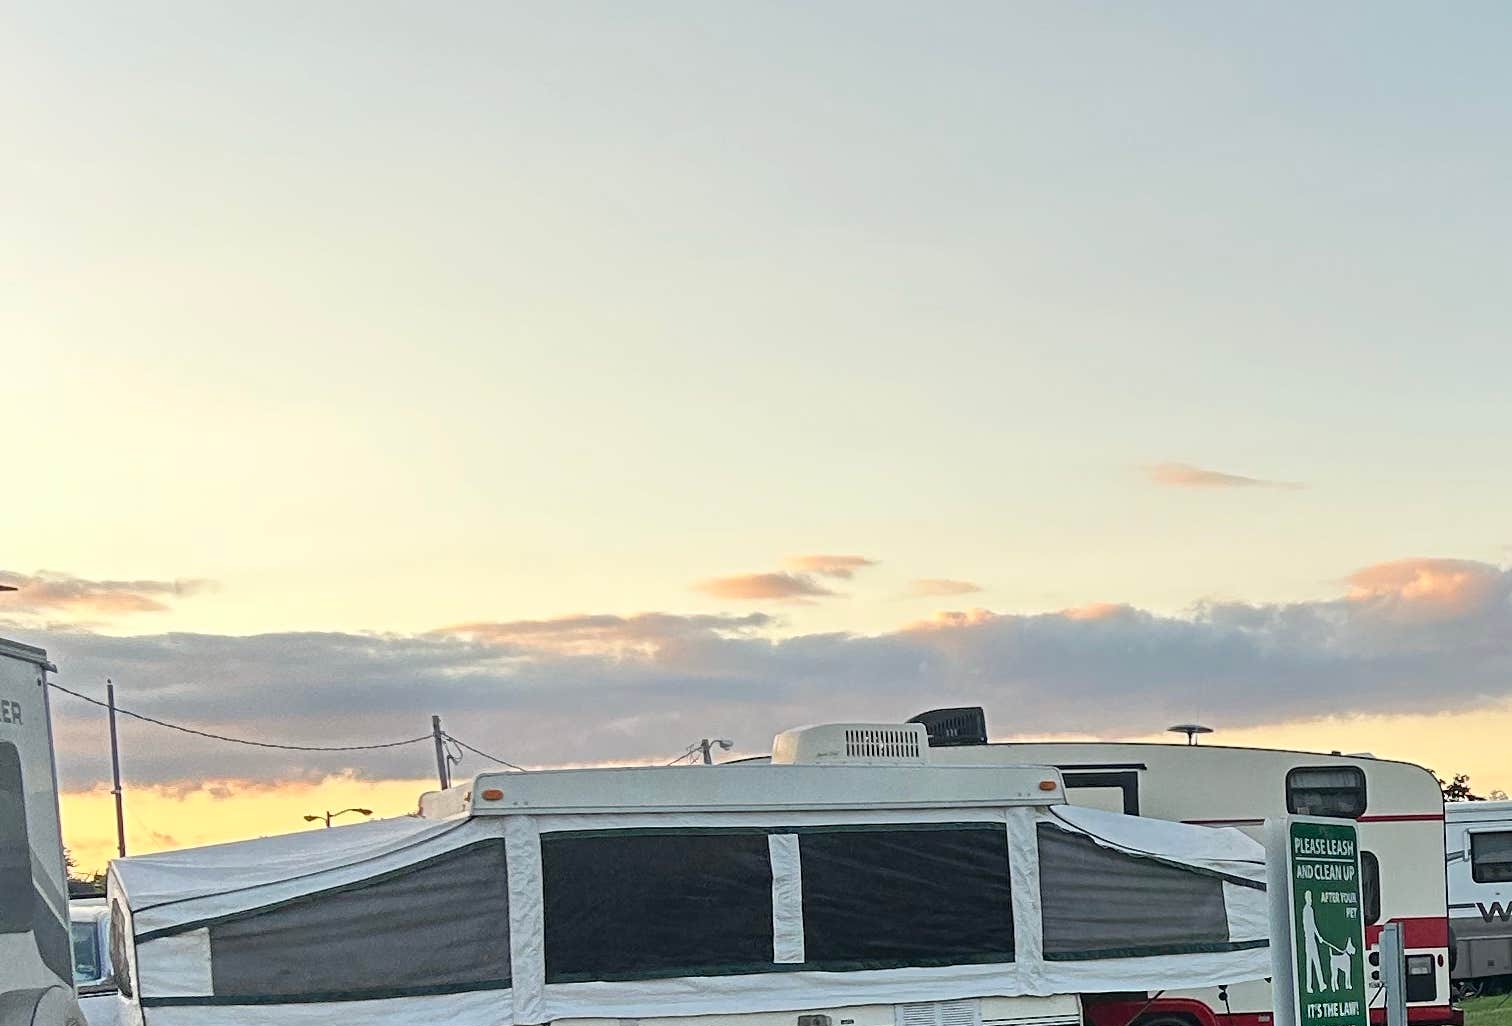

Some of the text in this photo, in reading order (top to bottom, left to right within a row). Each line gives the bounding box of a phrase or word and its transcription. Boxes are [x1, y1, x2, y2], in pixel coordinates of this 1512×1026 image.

[0, 699, 24, 725] ER
[1294, 837, 1354, 856] PLEASE LEASH
[1296, 864, 1355, 881] AND CLEAN UP
[1320, 891, 1357, 904] AFTER YOUR
[1345, 907, 1358, 919] PET
[1307, 1001, 1360, 1019] IT'S THE LAW!
